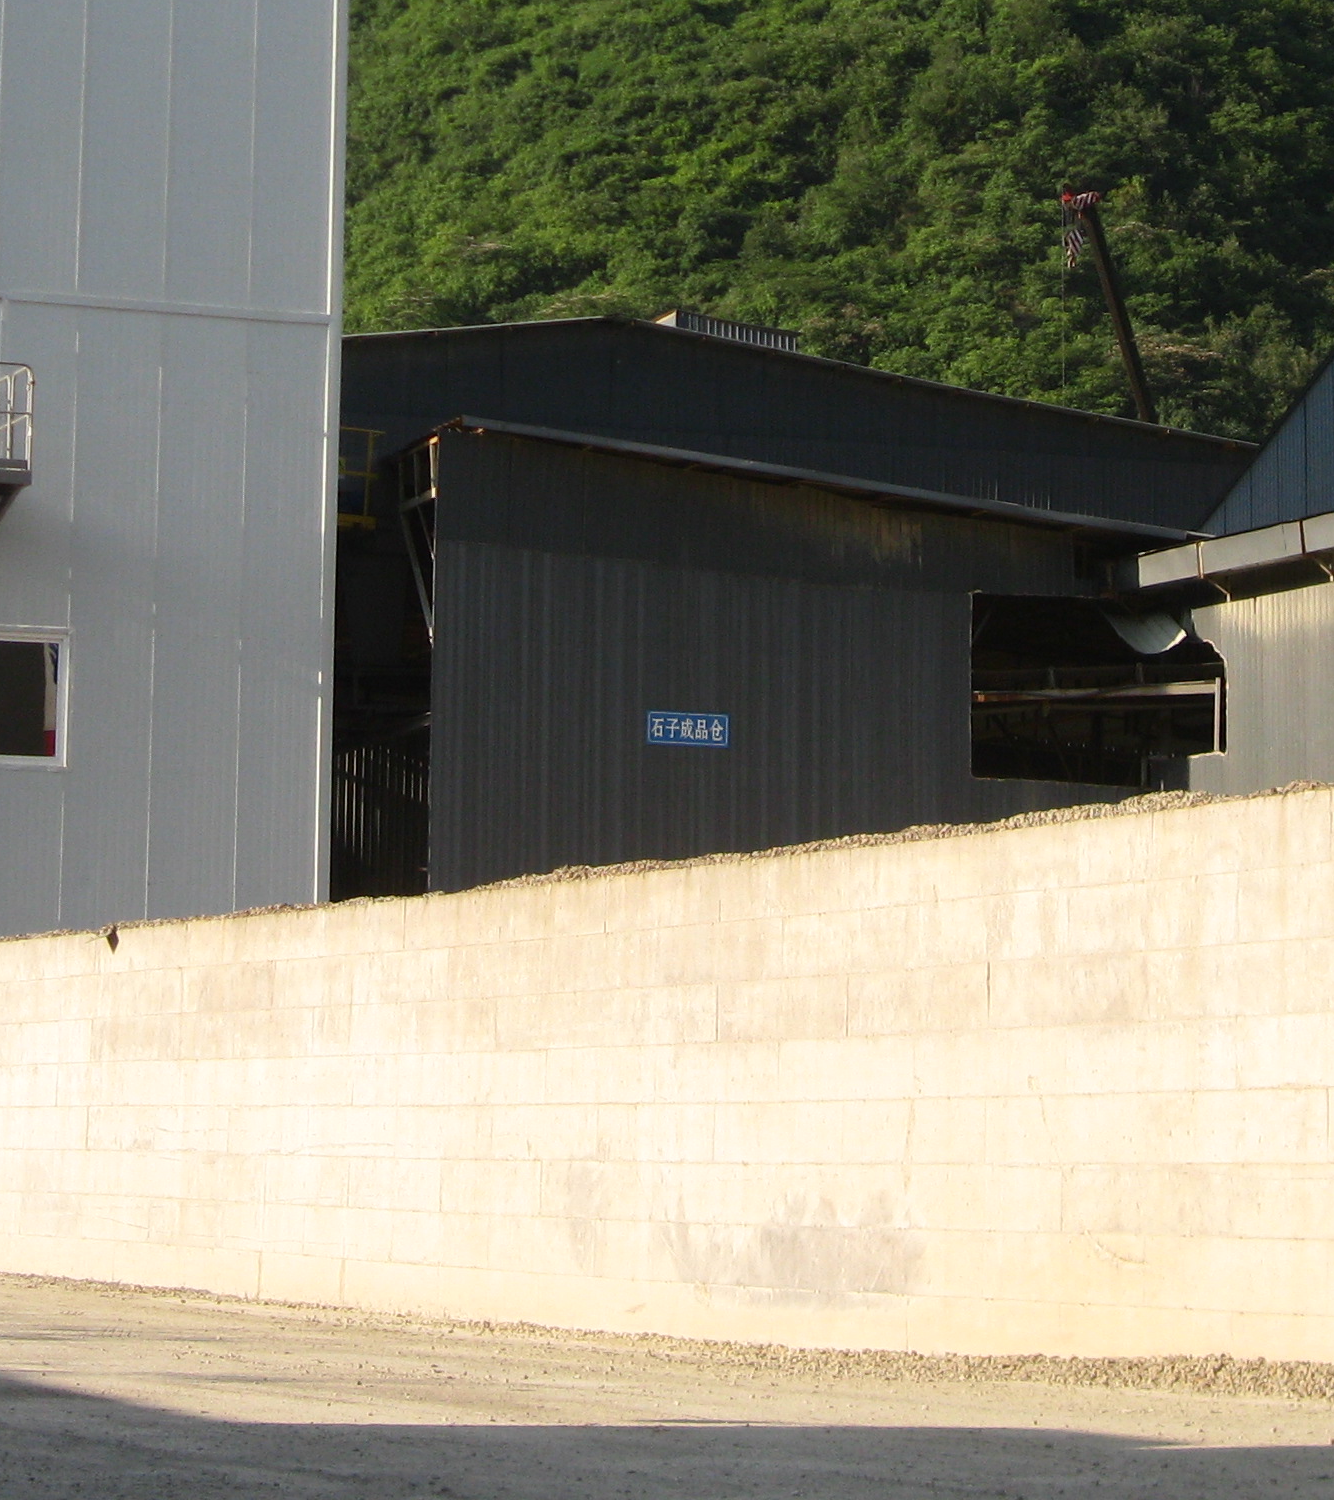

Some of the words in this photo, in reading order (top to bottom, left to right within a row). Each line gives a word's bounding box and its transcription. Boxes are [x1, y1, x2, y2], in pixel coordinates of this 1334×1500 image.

[651, 717, 724, 742] 石子成品仓
